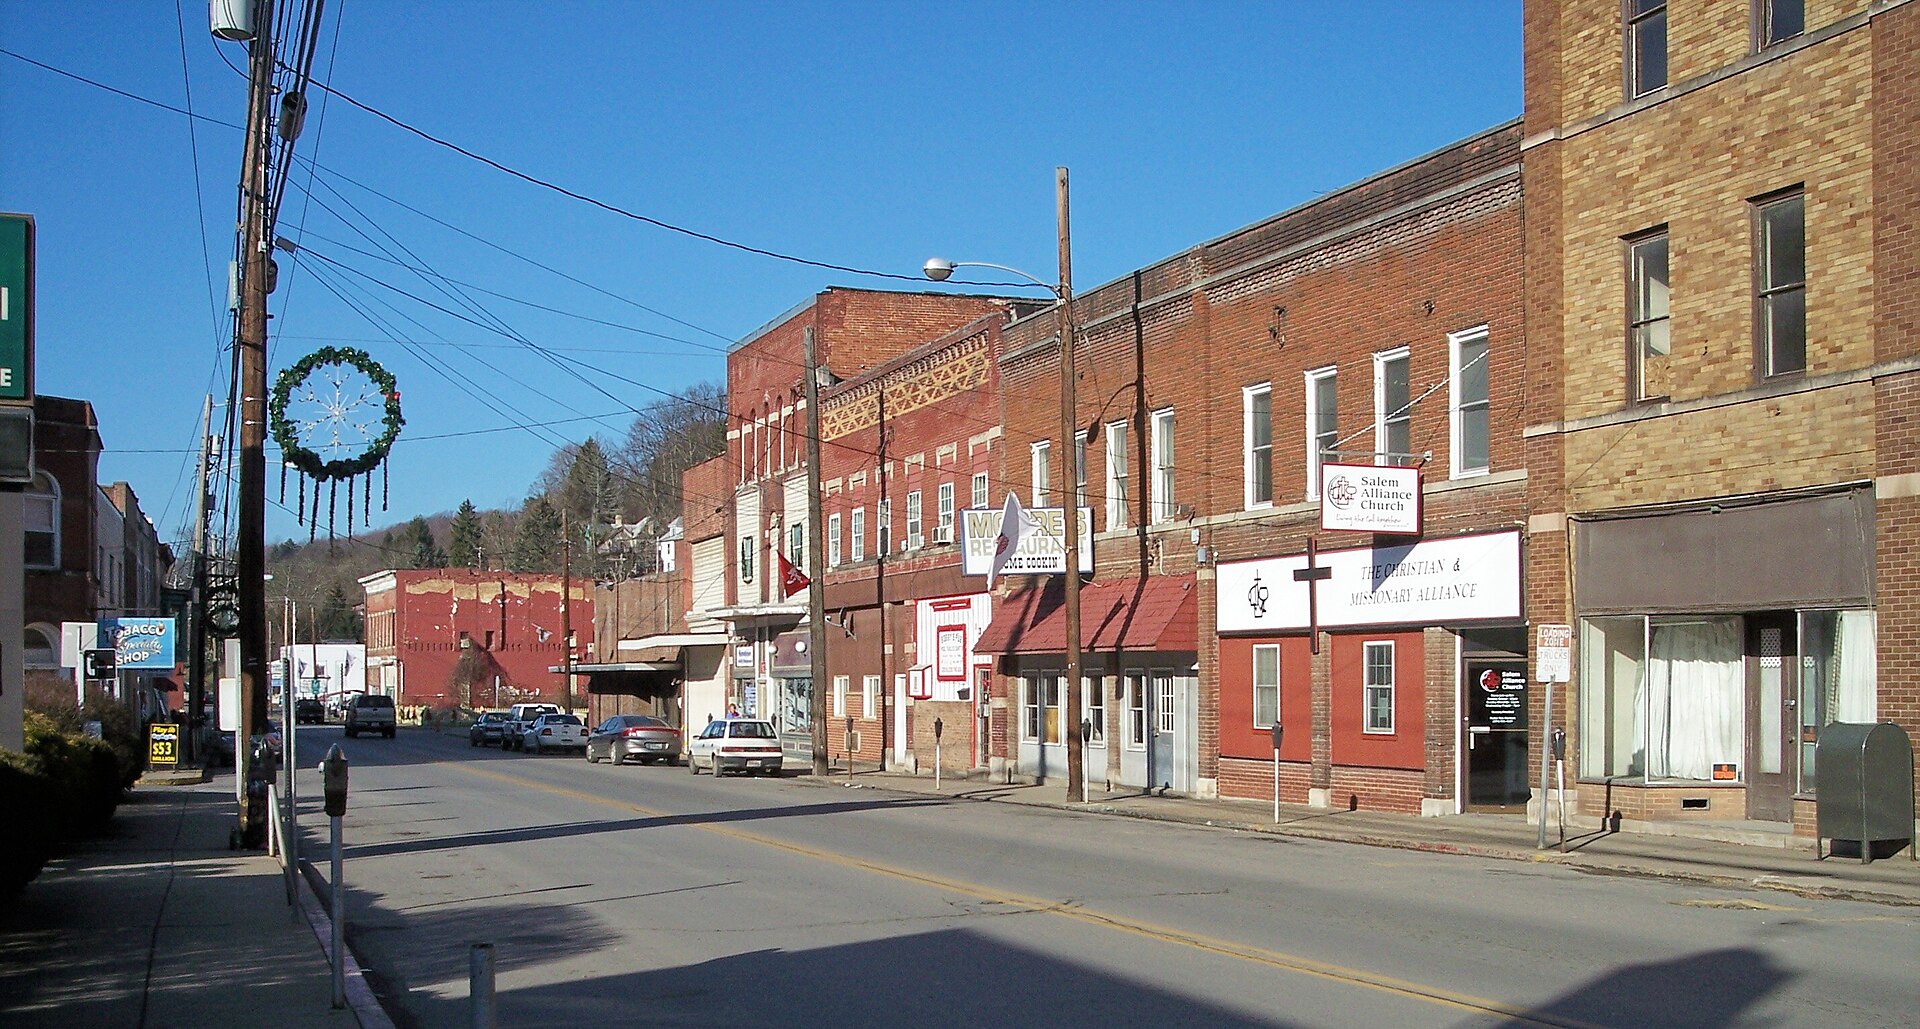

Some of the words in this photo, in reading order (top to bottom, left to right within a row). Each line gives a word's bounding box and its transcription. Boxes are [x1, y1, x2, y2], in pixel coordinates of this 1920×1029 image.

[1361, 476, 1399, 487] Salem
[1361, 488, 1412, 500] Alliance
[1361, 500, 1404, 511] Church
[1004, 557, 1022, 569] OME
[1361, 564, 1382, 580] THE
[1384, 559, 1445, 578] CHRISTIAN
[1350, 588, 1413, 606] MISSIONARY
[1416, 583, 1477, 602] ALLIANCE
[105, 624, 166, 639] TOBACCO
[1541, 629, 1569, 639] LOADING
[116, 635, 163, 654] Specialty
[1544, 637, 1565, 647] ZONE
[116, 651, 149, 665] SHOP
[1540, 651, 1568, 659] TRUCKS
